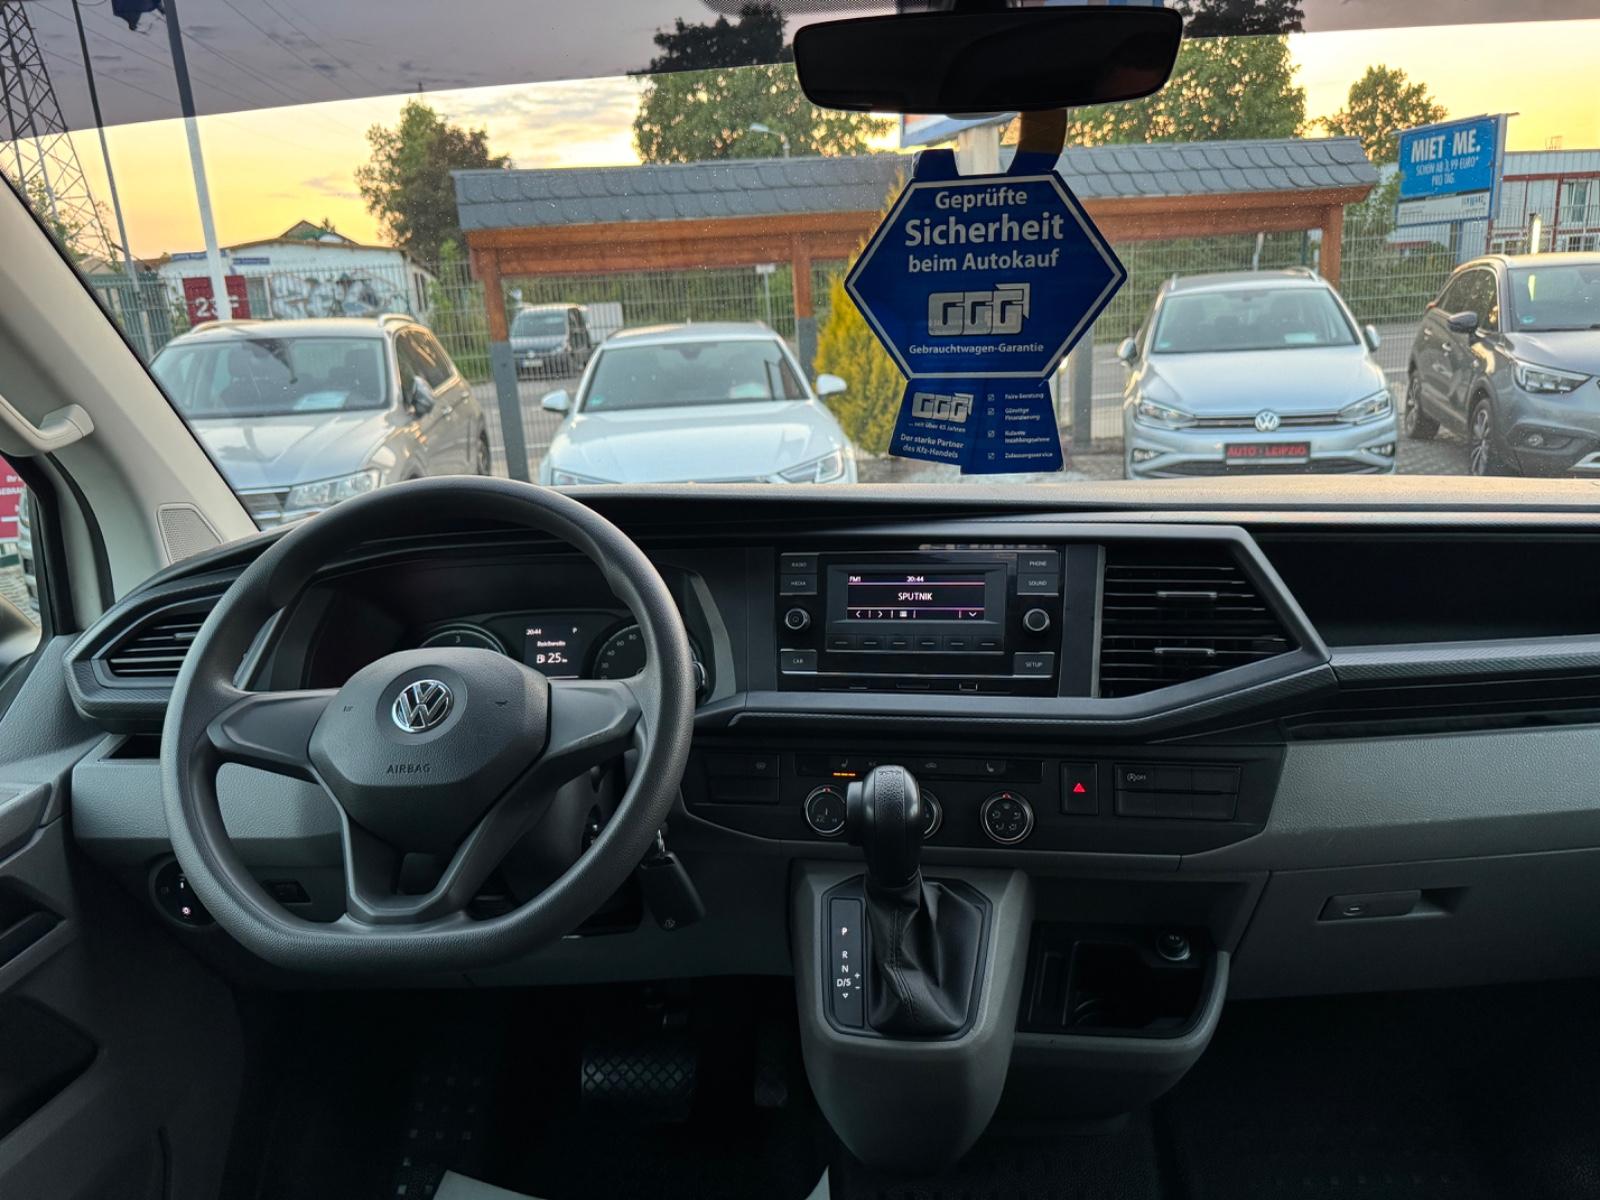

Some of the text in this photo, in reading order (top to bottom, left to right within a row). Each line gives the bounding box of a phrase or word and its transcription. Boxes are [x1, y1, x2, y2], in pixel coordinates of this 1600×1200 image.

[1411, 128, 1481, 164] MIET ME.
[935, 187, 1028, 212] Geprüfte
[904, 212, 1064, 247] Sicherheit
[908, 248, 1060, 273] beim Autokauf
[928, 284, 1029, 336] GGG
[909, 343, 1044, 355] Gebrauchtwagen-Garantie
[900, 433, 965, 449] Der starke Partner
[902, 443, 959, 459] des Kfz-Handels
[1227, 446, 1257, 457] AUTO
[897, 592, 933, 601] SPUTNIK
[525, 627, 578, 636] 20:44 P
[547, 652, 562, 664] 25
[387, 763, 431, 775] AIRBAG
[841, 927, 848, 936] P
[842, 950, 848, 959] R
[841, 965, 849, 973] N
[836, 978, 852, 988] D/S
